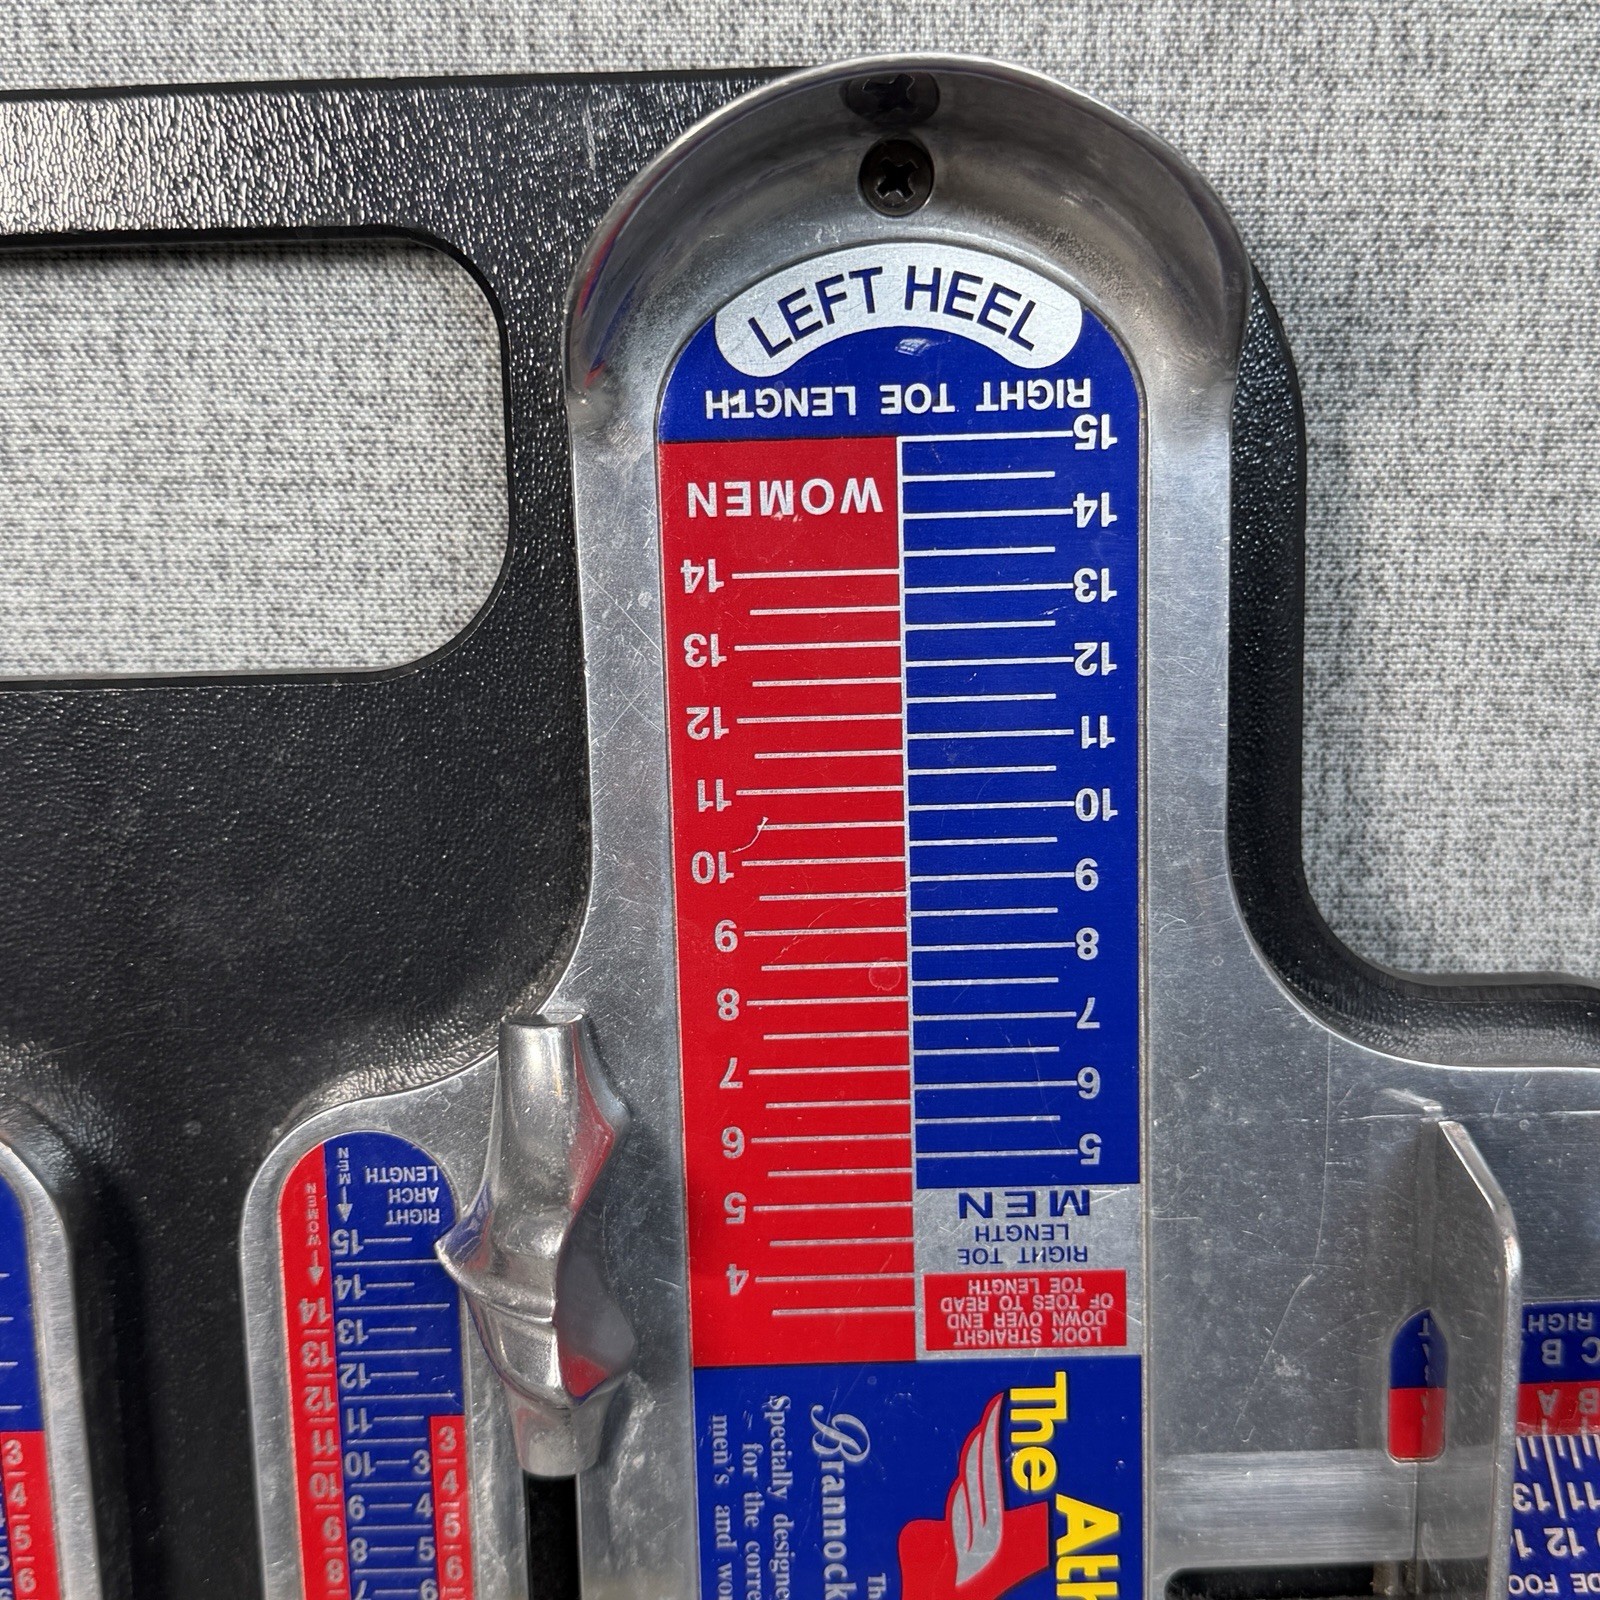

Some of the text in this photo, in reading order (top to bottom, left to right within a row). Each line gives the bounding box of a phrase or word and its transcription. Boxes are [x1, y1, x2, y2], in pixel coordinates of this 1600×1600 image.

[748, 265, 1036, 358] LEFT HEEL
[705, 378, 1091, 420] RIGHT TOE LENGTH
[1073, 414, 1117, 450] 15
[687, 476, 884, 518] WOMEN
[1073, 491, 1117, 528] 14
[680, 558, 724, 594] 14
[1073, 567, 1117, 603] 13
[683, 633, 727, 668] 13
[1074, 641, 1117, 676] 12
[686, 706, 729, 740] 12
[1080, 715, 1116, 749] 11
[696, 779, 732, 812] 11
[1074, 787, 1118, 821] 10
[691, 851, 734, 884] 10
[1074, 857, 1099, 891] 9
[714, 920, 738, 953] 9
[1075, 926, 1099, 960] 8
[717, 988, 740, 1021] 8
[1076, 997, 1100, 1029] 7
[719, 1058, 743, 1089] 7
[1077, 1066, 1101, 1099] 6
[721, 1126, 745, 1158] 6
[1078, 1133, 1102, 1165] 5
[338, 1147, 351, 1185] MEN
[366, 1166, 438, 1183] LENGTH
[389, 1187, 440, 1204] ARCH
[723, 1192, 747, 1225] 5
[958, 1189, 1090, 1219] MEN
[304, 1183, 321, 1246] WOMEN
[385, 1209, 440, 1225] RIGHT
[332, 1229, 364, 1255] 15
[975, 1223, 1069, 1242] LENGTH
[957, 1246, 1088, 1265] RIGHT TOE
[334, 1274, 366, 1300] 14
[725, 1263, 750, 1295] 4
[968, 1277, 1085, 1295] TOE LENGTH
[299, 1298, 331, 1324] 14
[940, 1293, 1114, 1313] OF TOES TO READ
[337, 1319, 369, 1344] 13
[947, 1310, 1107, 1329] DOWN OVER END
[953, 1327, 1102, 1346] LOOK STRAIGHT
[301, 1341, 333, 1367] 13
[1541, 1339, 1562, 1364] B
[340, 1363, 371, 1389] 12
[304, 1386, 335, 1412] 12
[1537, 1389, 1560, 1416] A
[347, 1408, 372, 1433] 11
[1010, 1371, 1068, 1491] The
[3, 1439, 23, 1465] 3
[311, 1429, 337, 1455] 11
[438, 1425, 457, 1452] 3
[764, 1395, 793, 1499] Specially
[344, 1451, 376, 1477] 10
[412, 1449, 430, 1475] 3
[742, 1443, 763, 1478] for
[10, 1481, 28, 1508] 4
[309, 1472, 340, 1499] 10
[441, 1469, 458, 1495] 4
[415, 1493, 433, 1518] 4
[744, 1492, 765, 1527] the
[1513, 1482, 1551, 1512] 13
[12, 1524, 32, 1550] 5
[443, 1512, 461, 1538] 5
[715, 1505, 738, 1550] and
[351, 1537, 368, 1563] 8
[417, 1536, 436, 1561] 5
[1543, 1527, 1586, 1557] 12
[16, 1567, 37, 1593] 6
[325, 1558, 345, 1584] 8
[446, 1555, 464, 1581] 6
